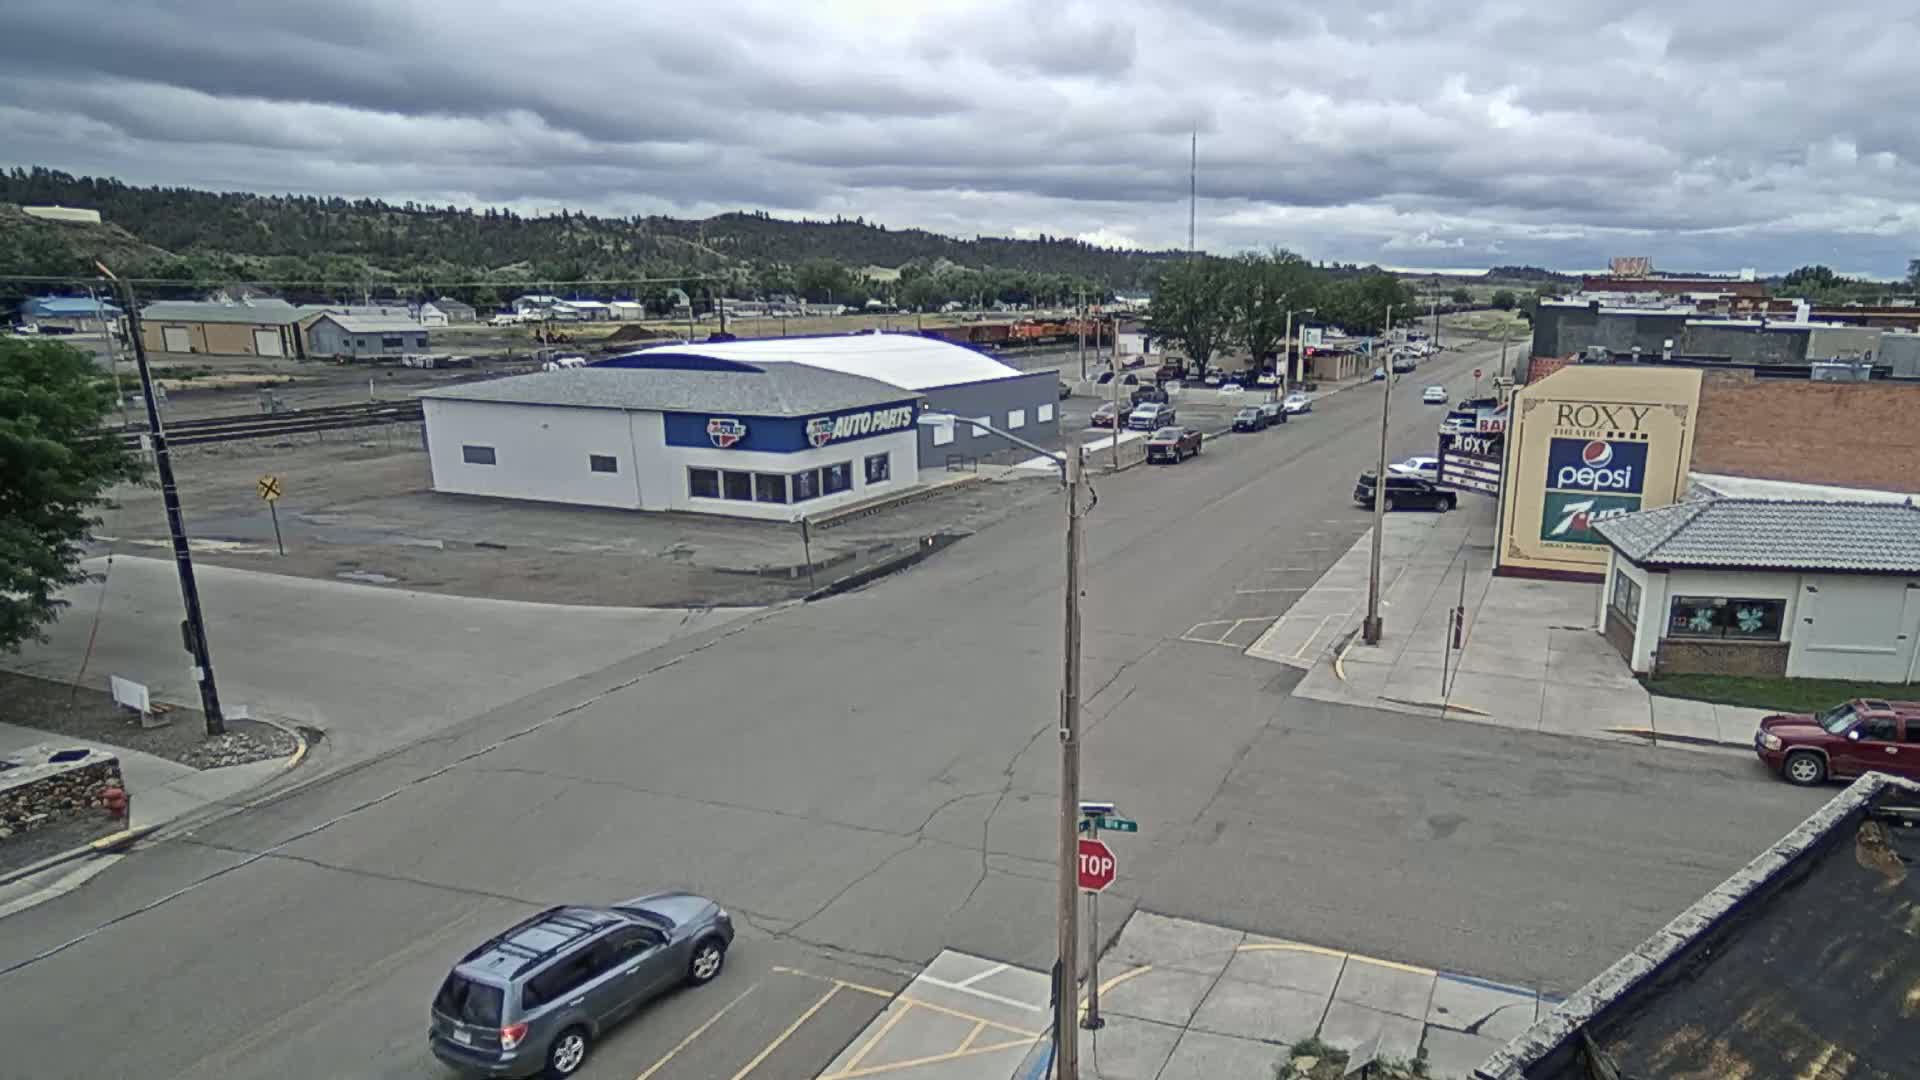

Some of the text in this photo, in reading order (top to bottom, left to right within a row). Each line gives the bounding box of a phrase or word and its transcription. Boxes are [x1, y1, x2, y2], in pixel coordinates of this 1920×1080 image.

[832, 412, 871, 439] AUTO
[871, 407, 912, 432] PARTS
[1557, 404, 1649, 430] ROXY
[1455, 433, 1493, 454] ROXY
[1557, 465, 1632, 491] pepsi
[1080, 854, 1112, 877] TOP
